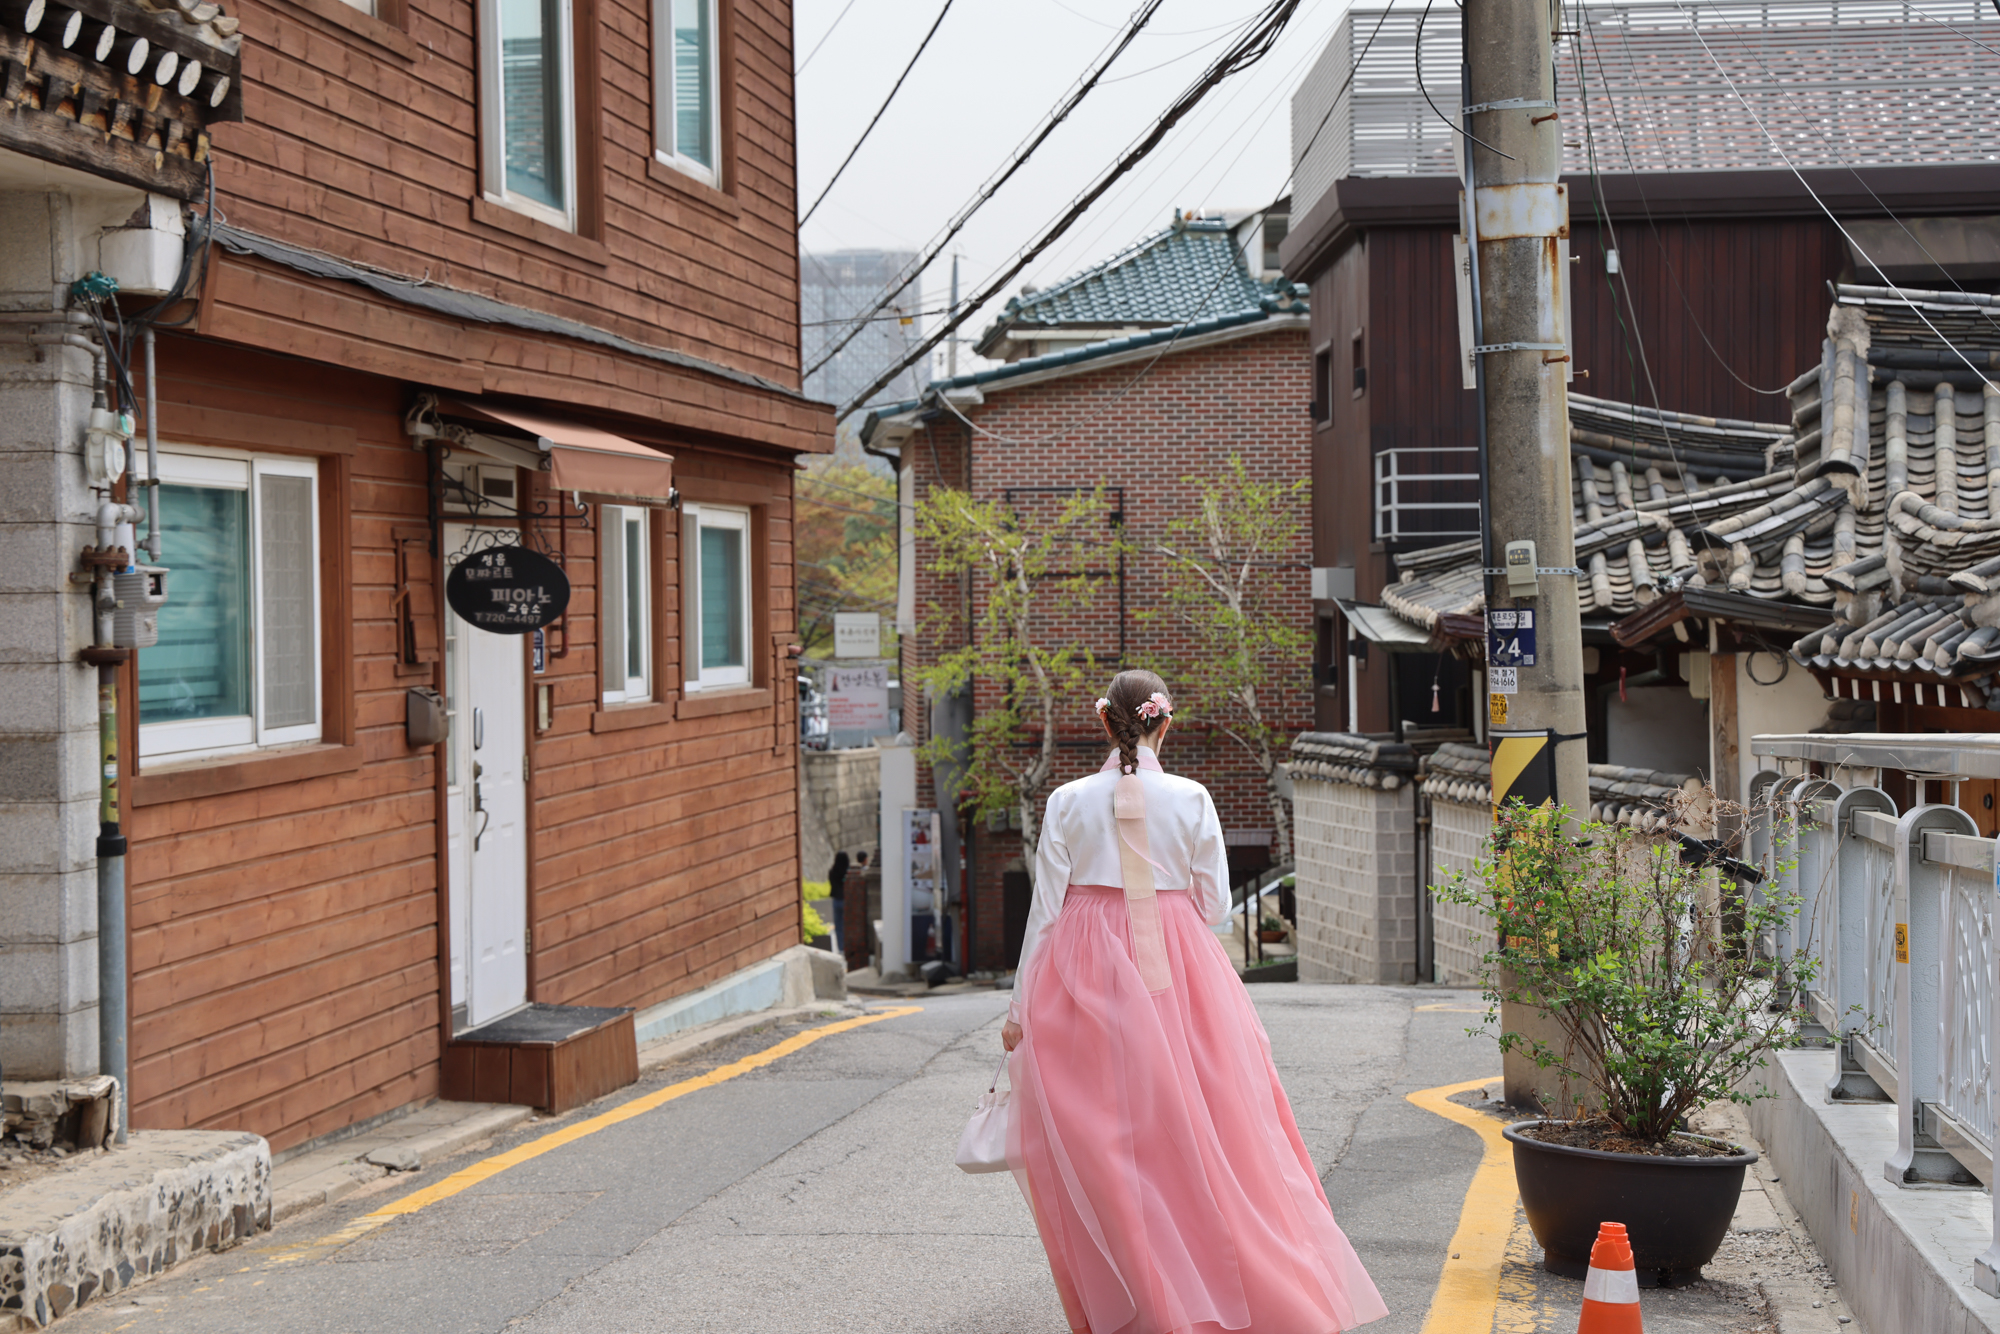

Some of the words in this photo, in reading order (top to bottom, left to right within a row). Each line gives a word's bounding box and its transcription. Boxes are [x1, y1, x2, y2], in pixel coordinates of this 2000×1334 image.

[465, 566, 513, 580] 모짜르트
[490, 586, 551, 604] 피아노
[507, 602, 541, 615] 교습소
[485, 613, 541, 624] 720-4497
